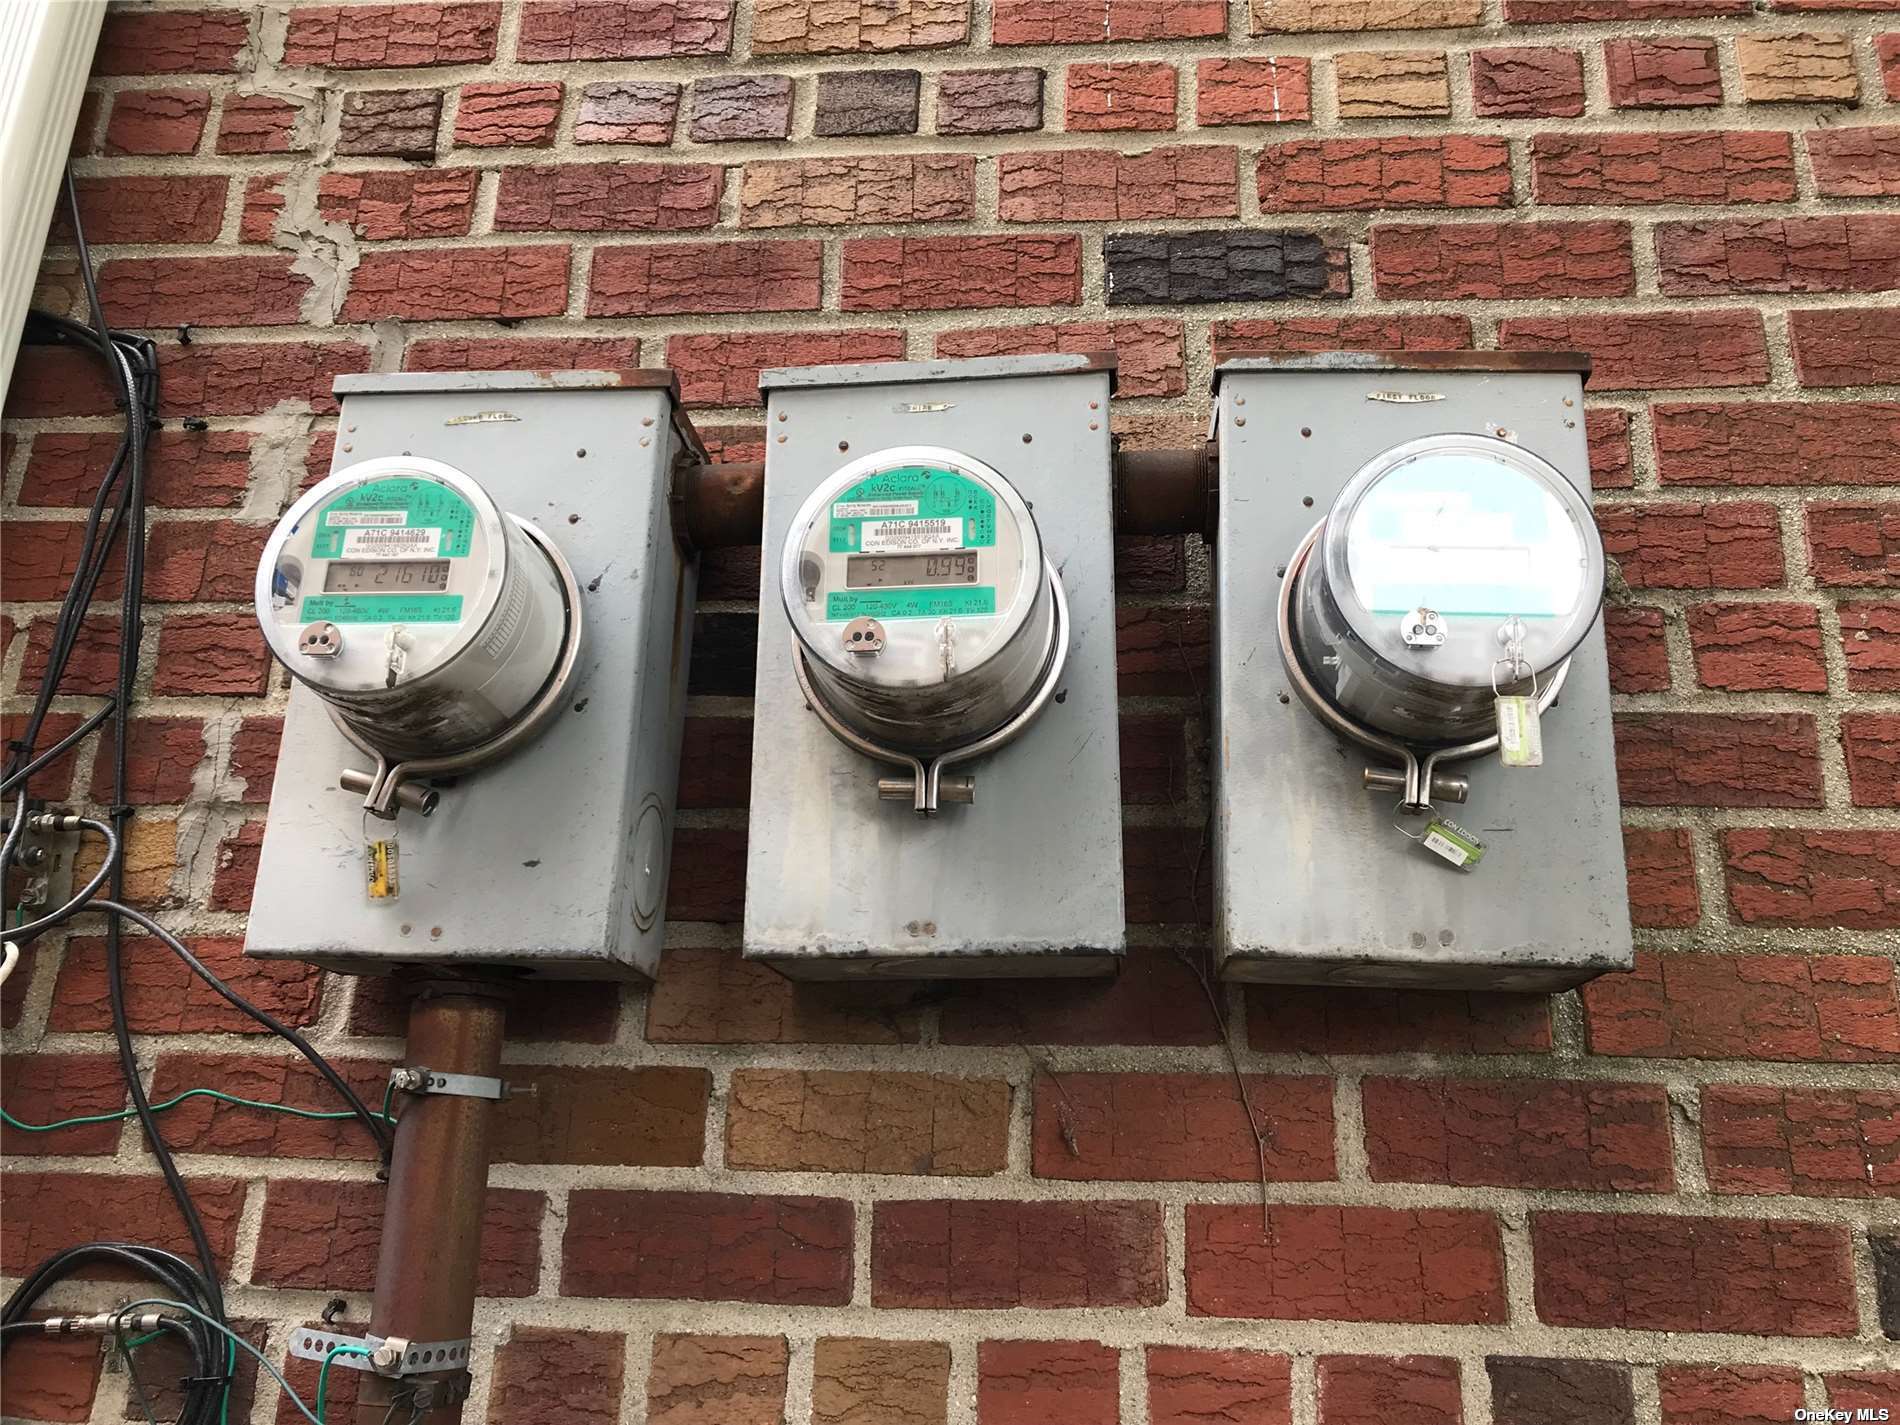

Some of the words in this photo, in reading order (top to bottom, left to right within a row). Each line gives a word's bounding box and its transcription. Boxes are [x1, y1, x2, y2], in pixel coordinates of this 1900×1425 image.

[882, 473, 919, 483] Aclara
[881, 520, 906, 529] A71C
[907, 518, 946, 528] 9415519
[364, 529, 387, 537] A71C
[390, 528, 426, 537] 9414629
